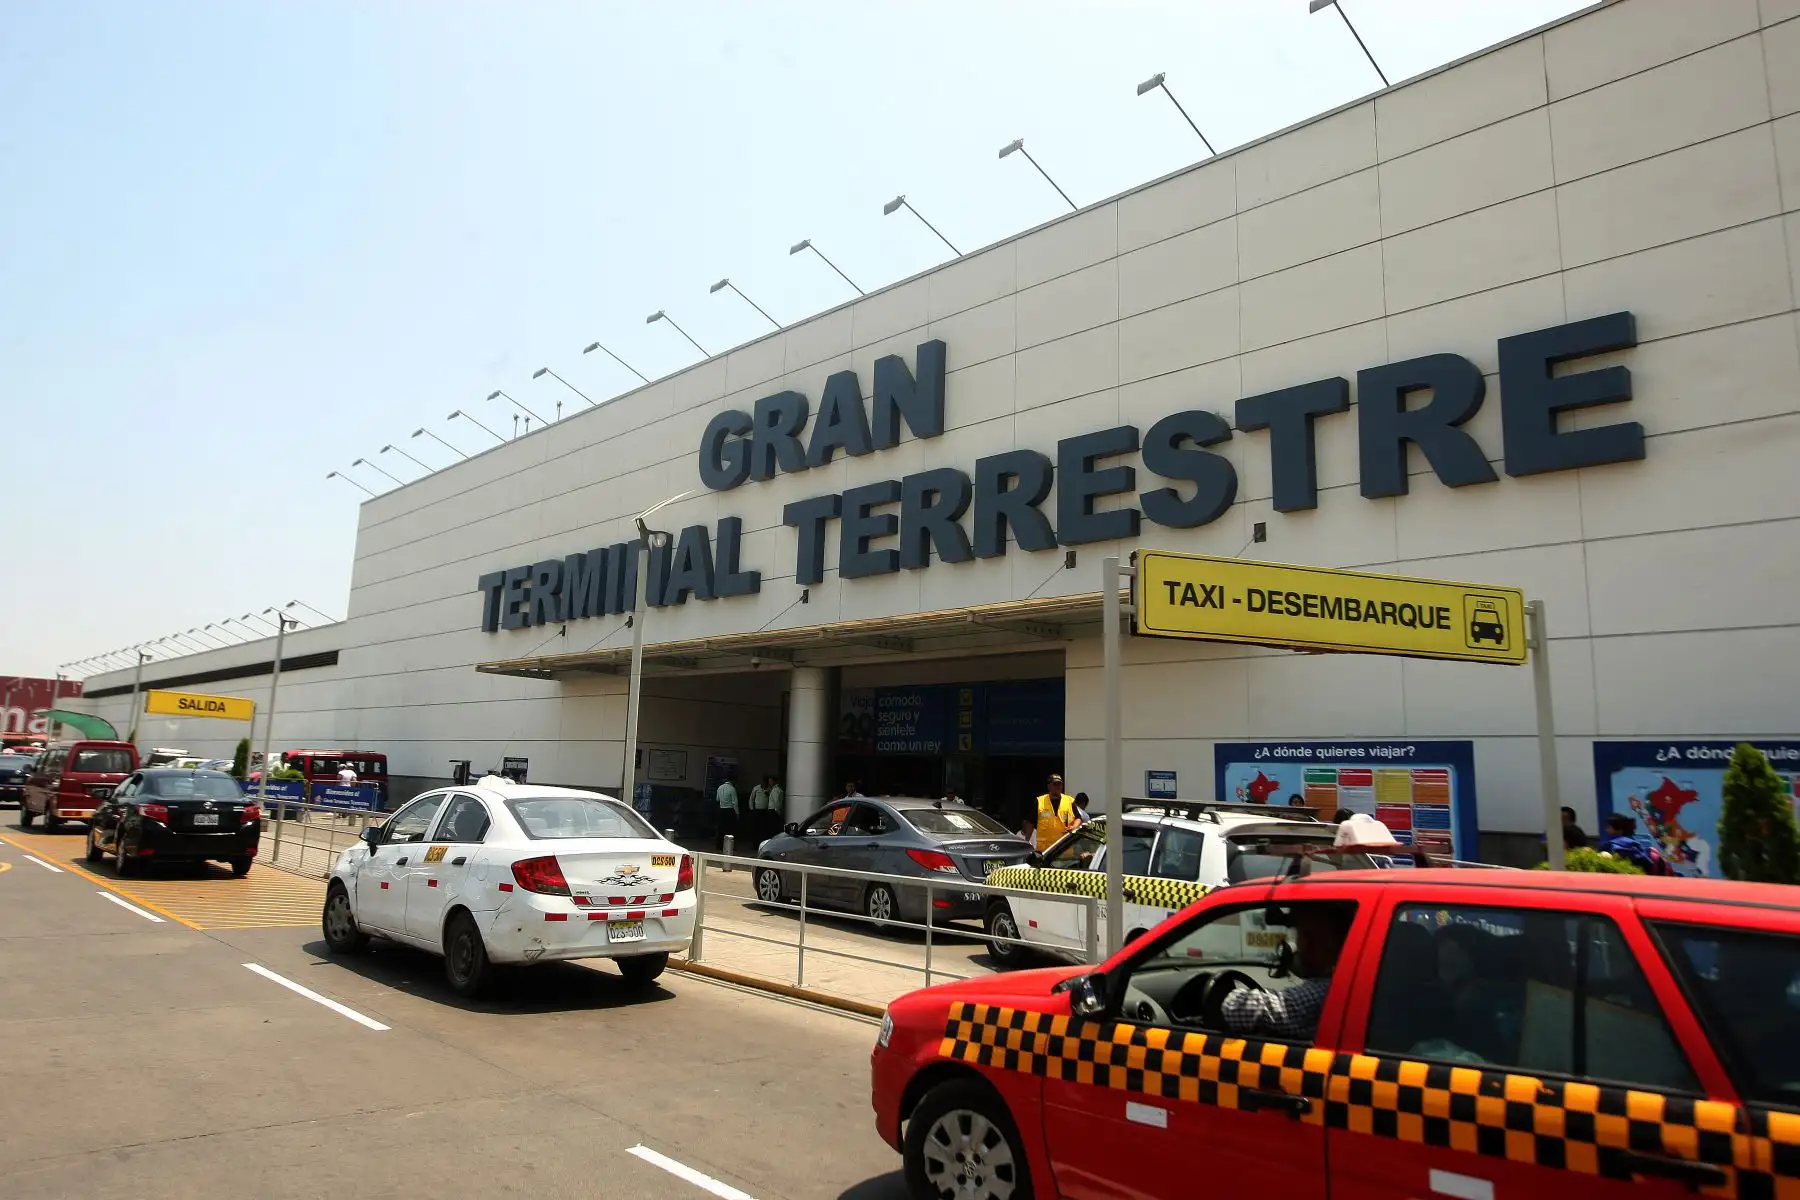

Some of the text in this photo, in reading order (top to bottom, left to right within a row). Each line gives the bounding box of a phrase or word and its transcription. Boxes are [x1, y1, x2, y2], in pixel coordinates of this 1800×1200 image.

[699, 339, 946, 491] GRAN
[478, 311, 1646, 633] TERMINAL TERRESTRE
[1163, 580, 1224, 609] TAXI
[1247, 588, 1451, 629] DESEMBARQUE
[178, 698, 226, 712] SALIDA
[877, 712, 912, 725] seguro
[908, 740, 922, 751] un
[924, 740, 942, 754] rey
[1254, 745, 1416, 759] ¿A dónde quieres viajar?
[1656, 747, 1681, 761] ¿A
[1686, 746, 1736, 760] dónd
[651, 855, 676, 867] D2S-500
[609, 926, 644, 939] D2S-500
